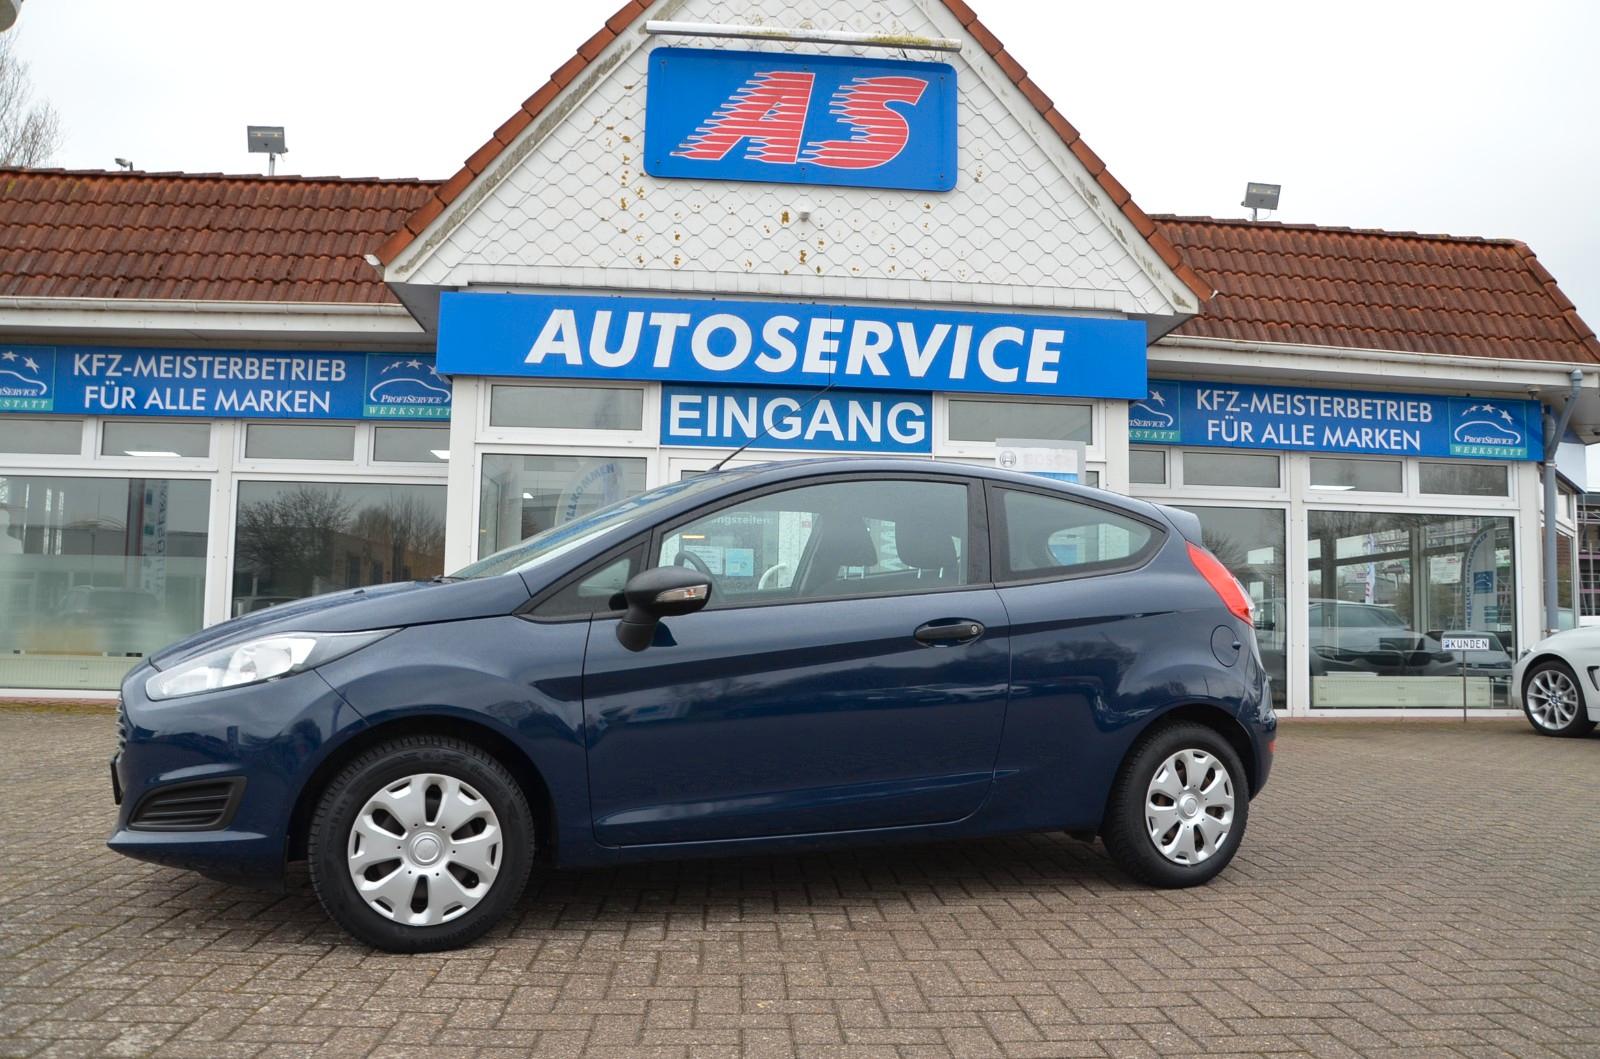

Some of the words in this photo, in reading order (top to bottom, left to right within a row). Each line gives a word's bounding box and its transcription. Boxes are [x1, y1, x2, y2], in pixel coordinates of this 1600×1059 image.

[669, 71, 930, 170] AS
[524, 308, 1066, 385] AUTOSERVICE
[73, 353, 347, 382] KFZ-MEISTERBETRIEB
[84, 380, 137, 411] FÜR
[143, 389, 207, 411] ALLE
[213, 389, 331, 413] MARKEN
[1196, 388, 1433, 423] KFZ-MEISTERBETRIEB
[669, 394, 927, 444] EINGANG
[1207, 415, 1253, 443] FÜR
[1259, 423, 1316, 446] ALLE
[1322, 427, 1421, 451] MARKEN
[1455, 446, 1524, 456] WERKSTATT
[1450, 640, 1488, 648] KUNDEN
